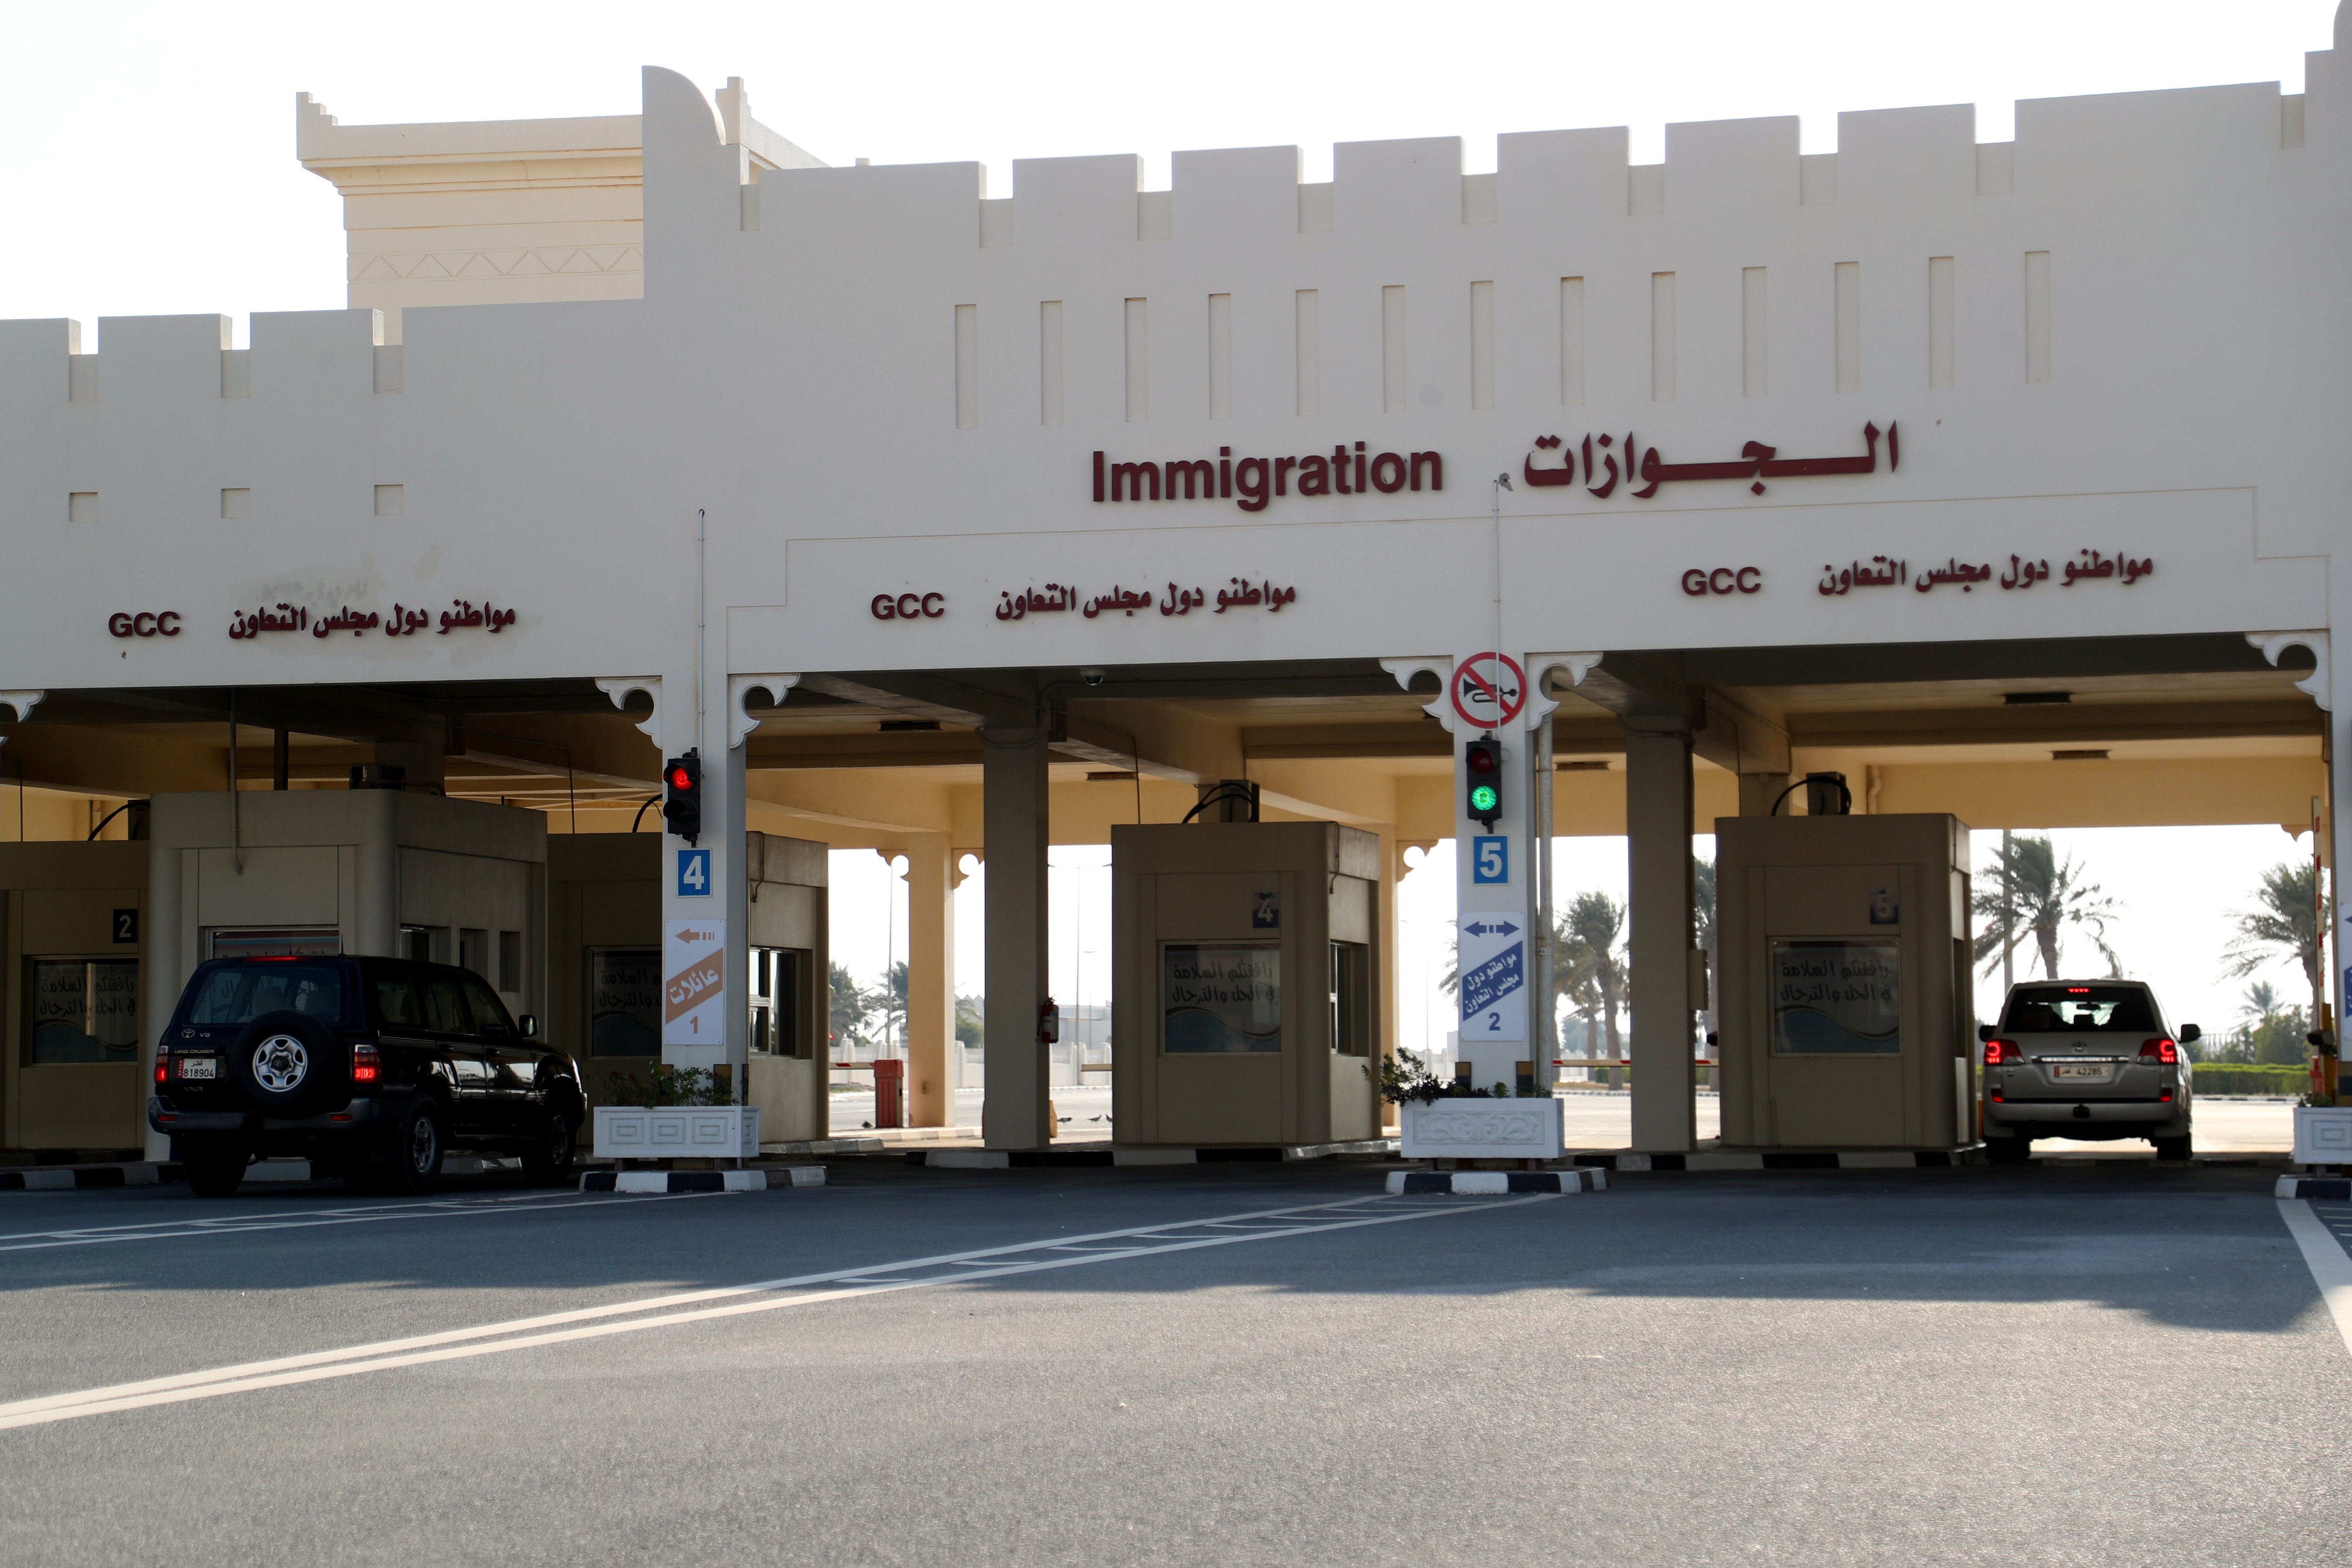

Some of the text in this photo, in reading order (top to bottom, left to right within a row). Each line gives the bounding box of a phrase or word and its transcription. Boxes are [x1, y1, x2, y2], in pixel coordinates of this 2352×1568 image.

[1093, 441, 1442, 512] Immigration
[1682, 567, 1761, 596] GCC
[1818, 549, 2153, 596] مواطنو دول مجلس التعاون
[871, 593, 944, 620] GCC
[995, 577, 1296, 621] مواطنو دول مجلس التعاون
[109, 611, 180, 638] GCC
[229, 599, 516, 640] مواطنو دول مجلس التعاون
[1479, 843, 1503, 877] 5
[683, 856, 705, 890] 4
[1257, 898, 1274, 923] 4
[1876, 894, 1893, 919] 5
[119, 915, 131, 938] 2
[601, 968, 648, 985] السلامة
[1173, 962, 1223, 979] السلامة
[1467, 953, 1517, 991] مواطنو دول
[1782, 959, 1836, 977] السلامة
[670, 969, 719, 1005] عائلات
[1172, 983, 1275, 1004] في الحل والترحال
[1465, 973, 1520, 1014] مجلس التعاون
[1781, 982, 1892, 1003] في الحل والترحال
[96, 997, 123, 1014] الحل
[127, 996, 136, 1016] في
[690, 1016, 699, 1034] 1
[1489, 1012, 1501, 1031] 2
[184, 1069, 214, 1078] 818904
